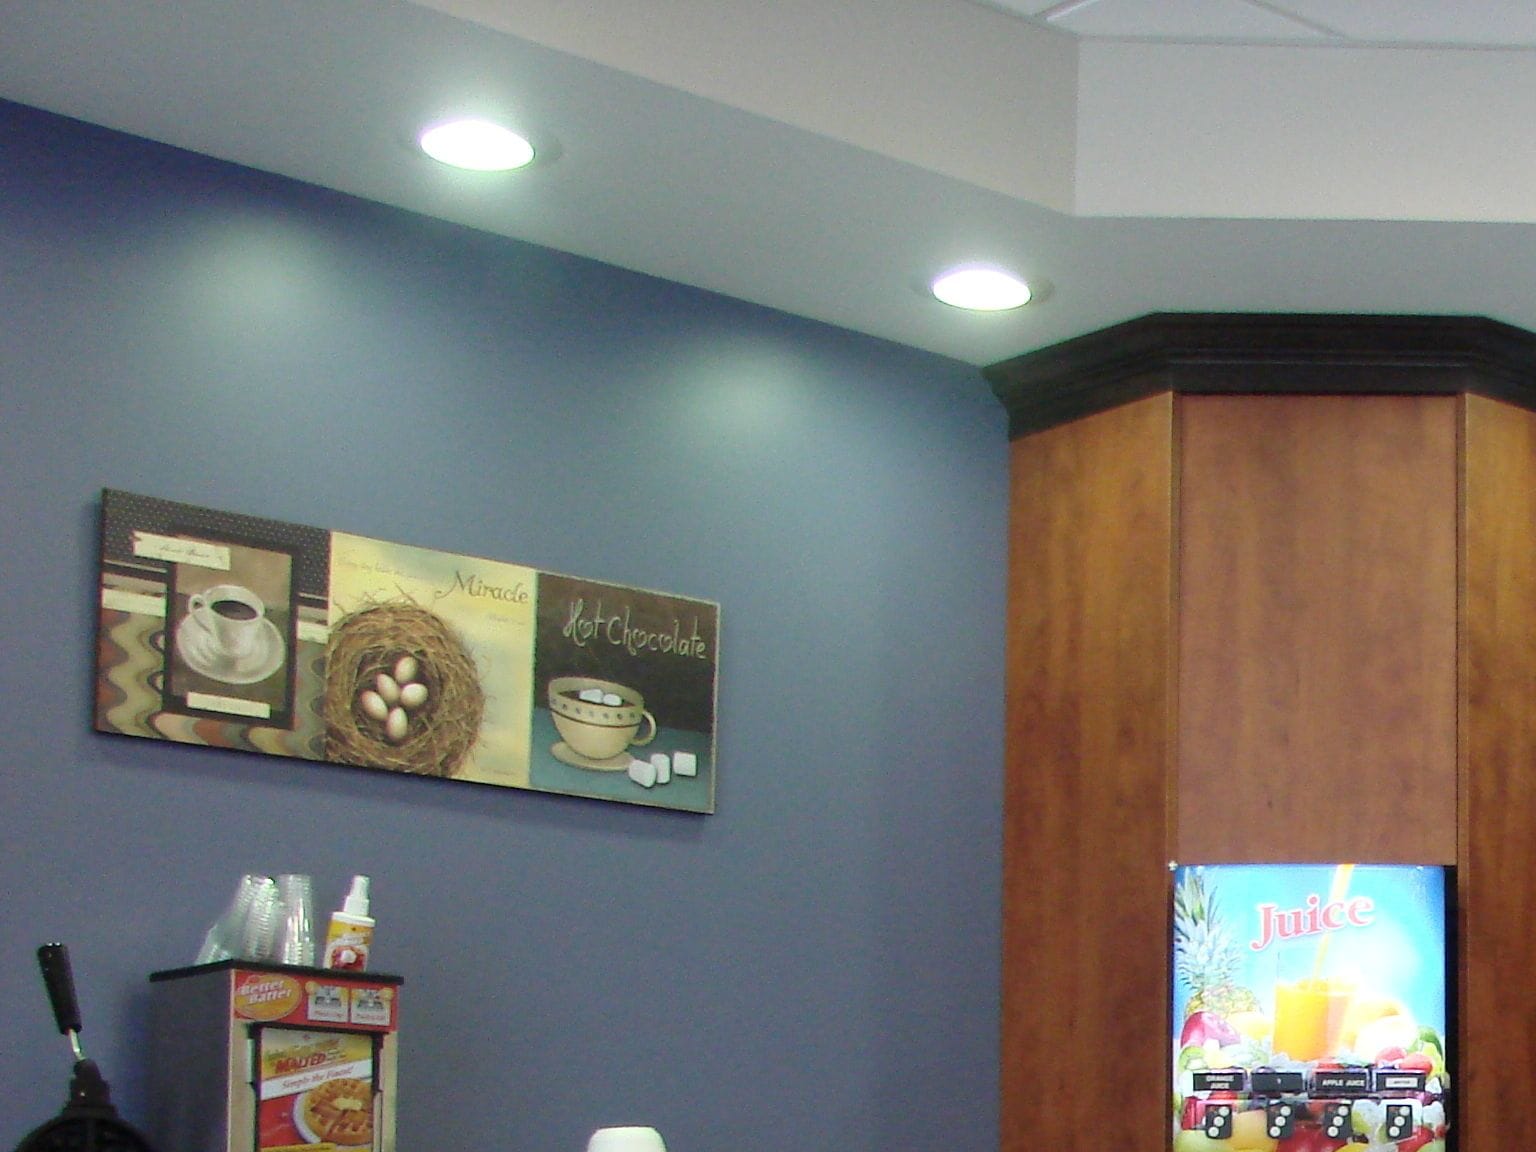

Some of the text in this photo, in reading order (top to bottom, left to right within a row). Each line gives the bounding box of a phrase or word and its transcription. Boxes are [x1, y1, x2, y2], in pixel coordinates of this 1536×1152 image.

[434, 570, 529, 604] Miracle
[563, 598, 707, 659] Hot Chocolate
[1251, 896, 1372, 950] Juice
[1322, 1079, 1366, 1087] APPLE JUICE
